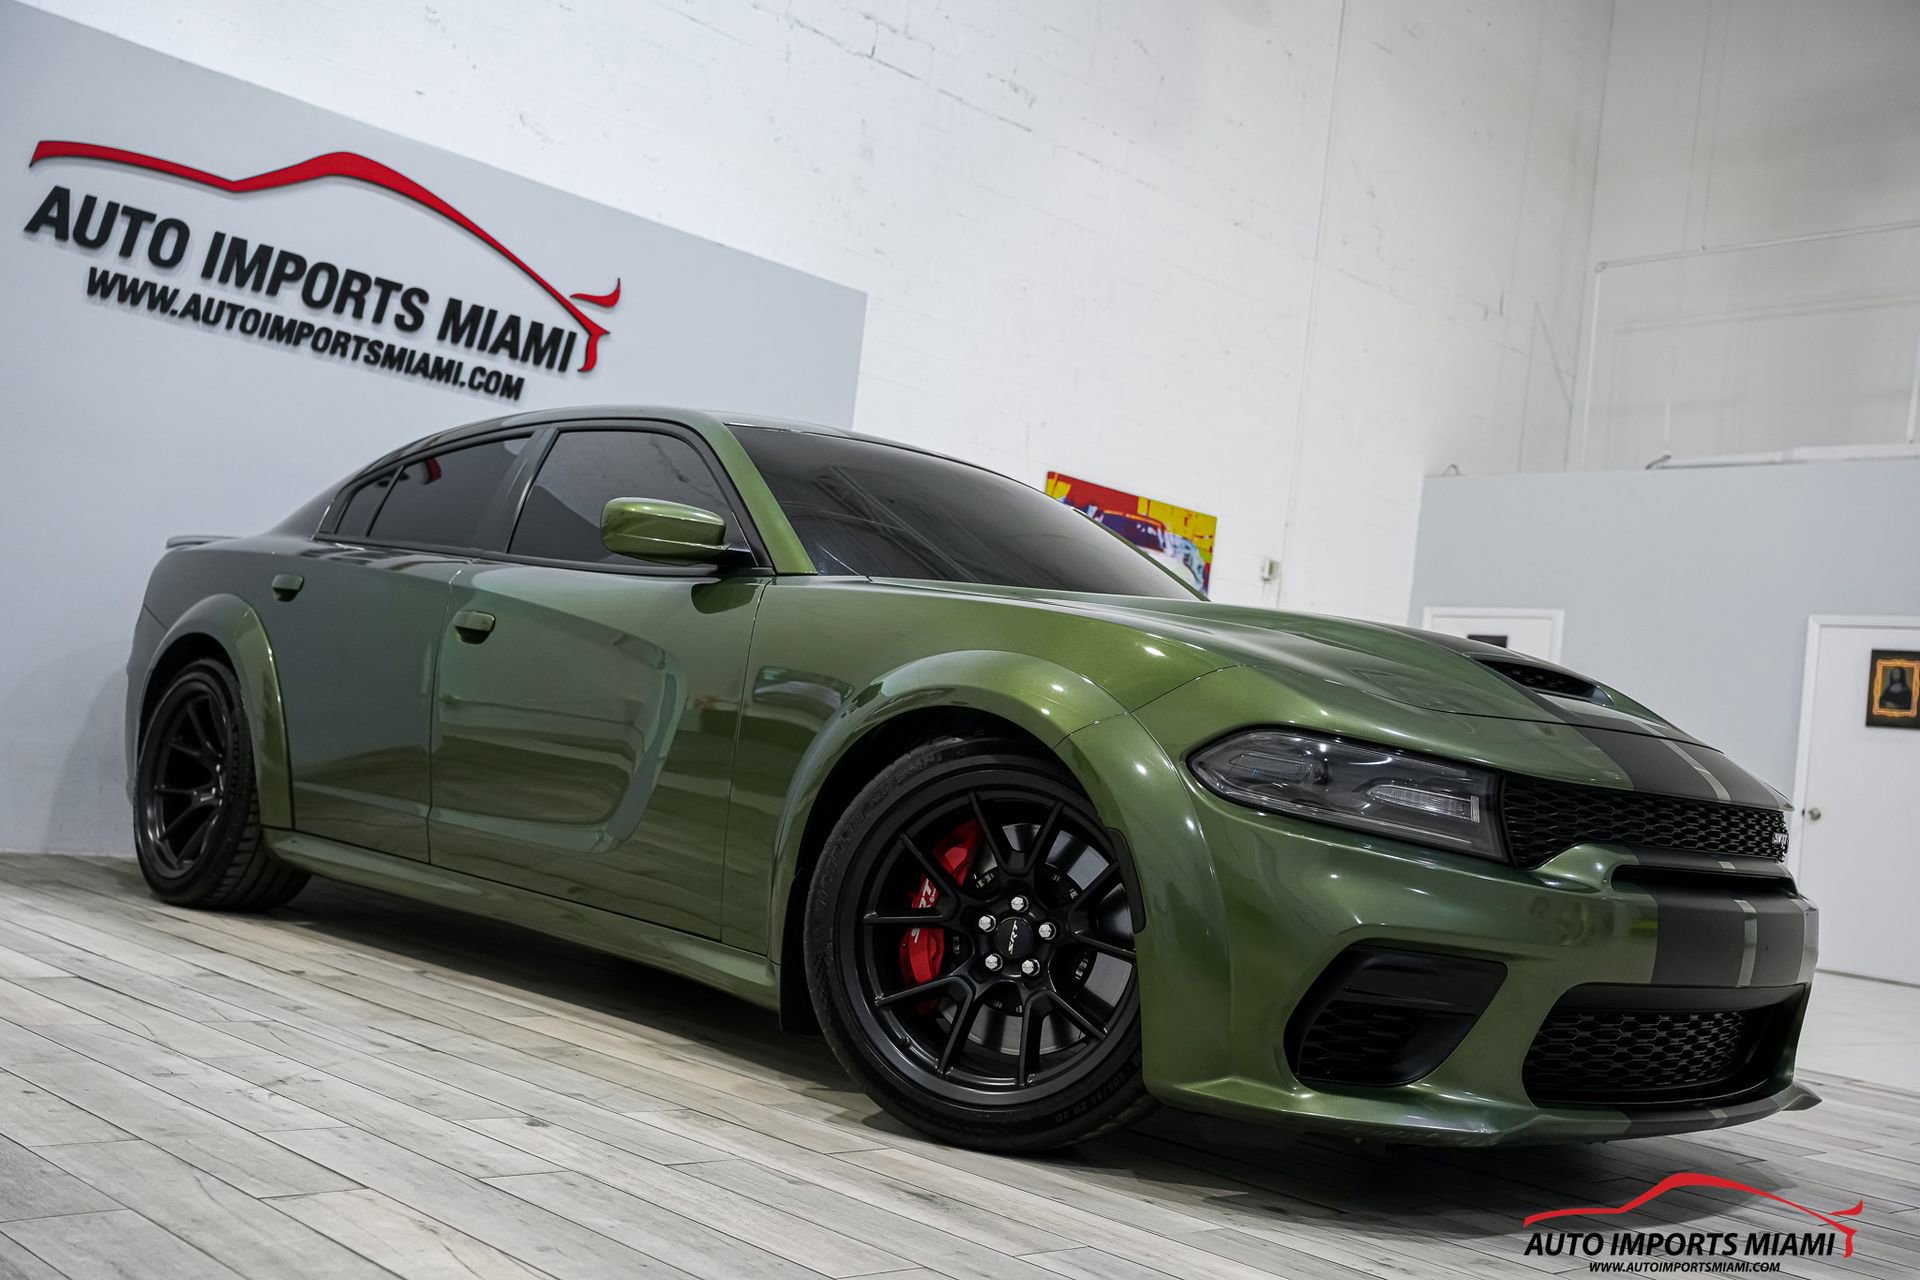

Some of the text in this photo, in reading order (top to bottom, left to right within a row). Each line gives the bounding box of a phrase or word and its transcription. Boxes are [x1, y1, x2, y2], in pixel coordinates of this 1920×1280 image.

[24, 185, 579, 372] AUTO IMPORTS MIAMI
[86, 267, 525, 401] WWW.AUTOIMPORTSMIAMI.COM
[1008, 920, 1018, 955] SRT
